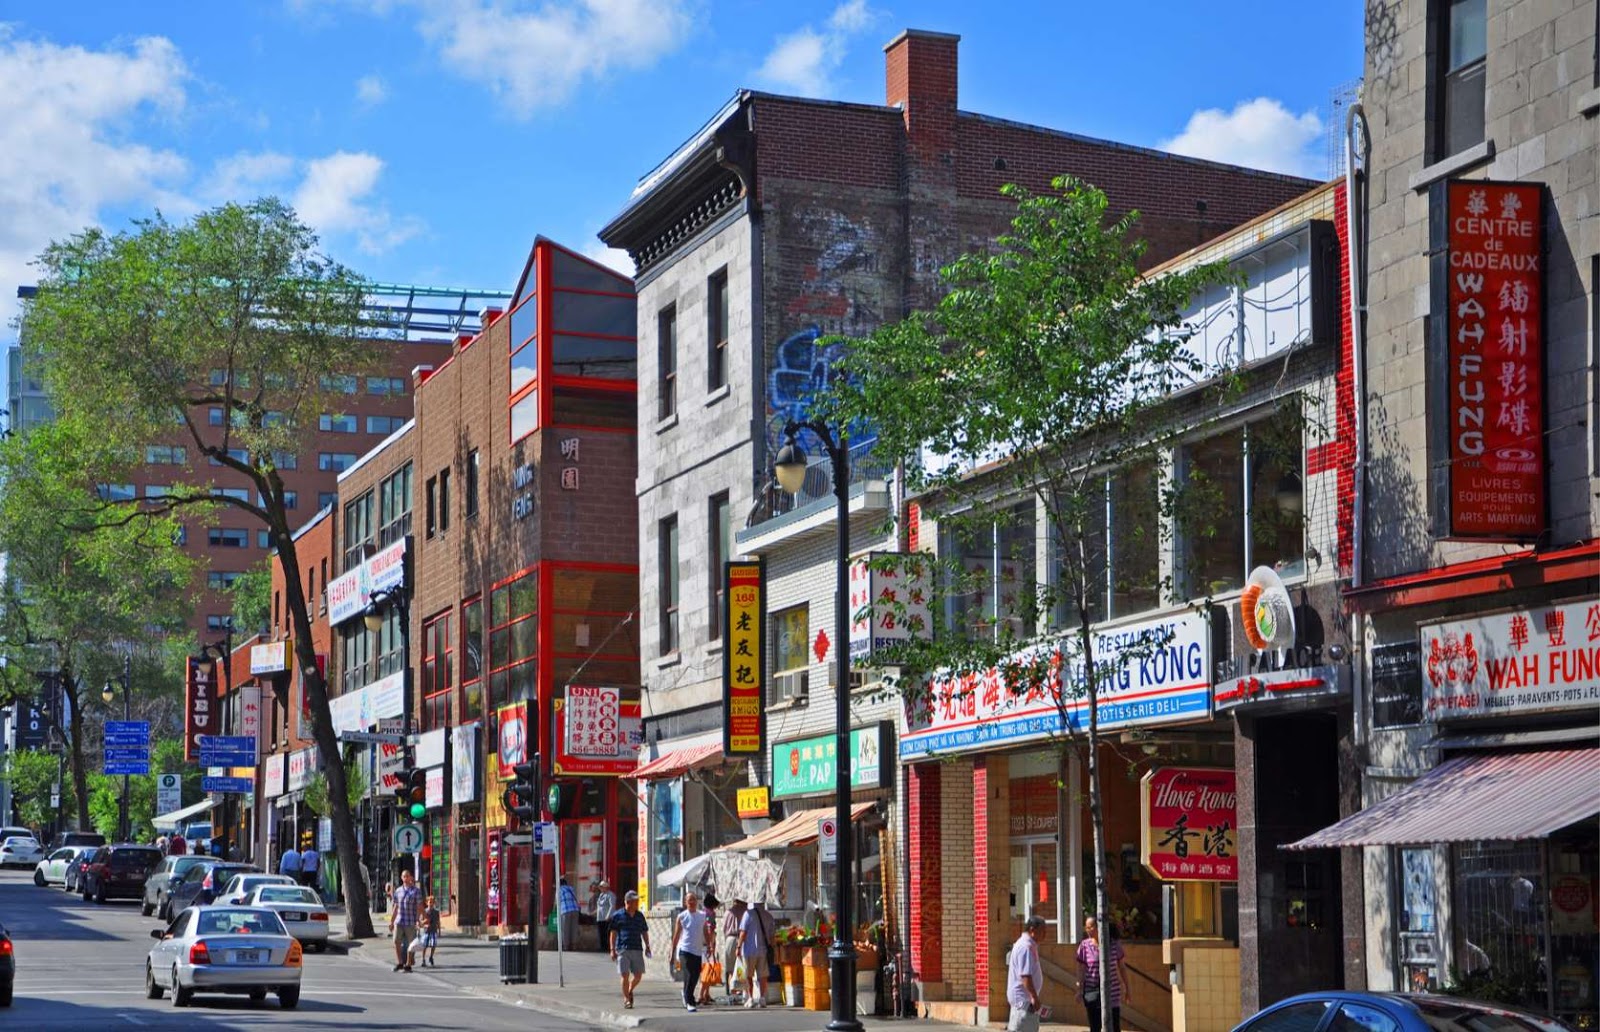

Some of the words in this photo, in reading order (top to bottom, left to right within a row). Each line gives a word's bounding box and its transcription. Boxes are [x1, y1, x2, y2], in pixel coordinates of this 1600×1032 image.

[1455, 217, 1532, 237] CENTRE
[1450, 251, 1538, 271] CADEAUX
[1472, 478, 1520, 489] LIVRES
[1483, 504, 1511, 512] POUR
[1460, 512, 1482, 522] ARTS
[1488, 513, 1536, 525] MARTIAUX
[736, 612, 755, 685] 老友記
[1140, 642, 1202, 687] KONG
[1485, 655, 1539, 690] WAH
[571, 688, 598, 697] UNI
[1157, 698, 1180, 713] DELI
[1157, 814, 1233, 858] 香港
